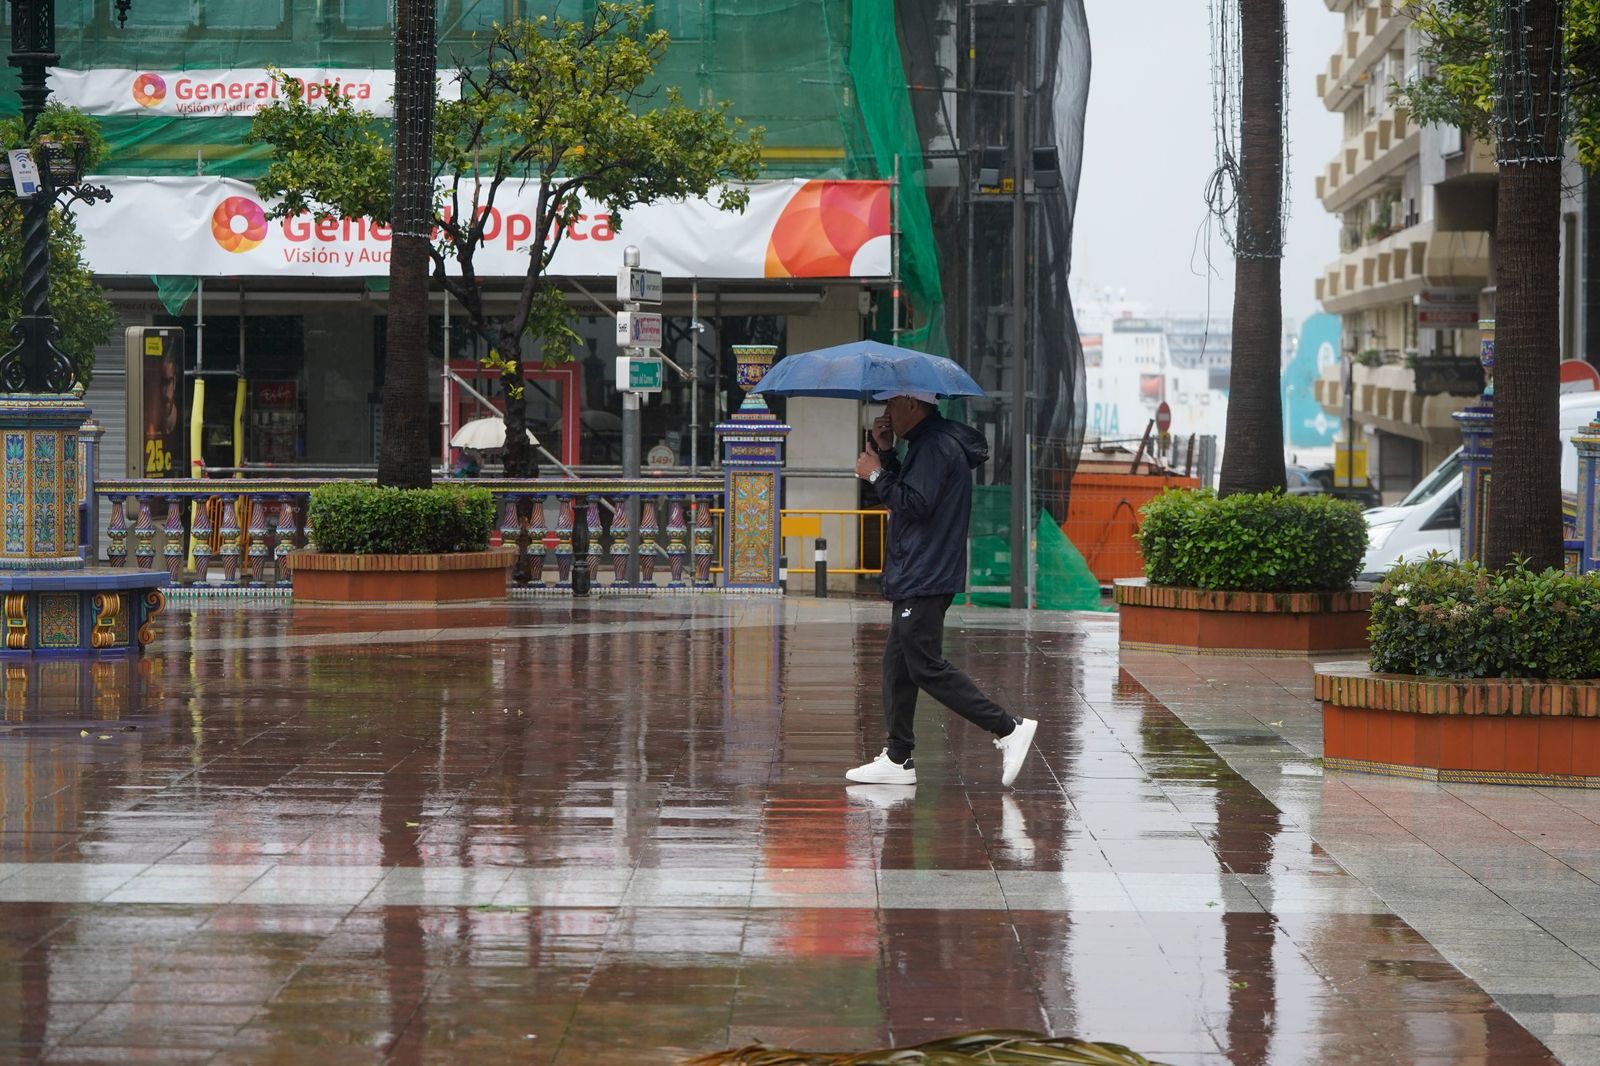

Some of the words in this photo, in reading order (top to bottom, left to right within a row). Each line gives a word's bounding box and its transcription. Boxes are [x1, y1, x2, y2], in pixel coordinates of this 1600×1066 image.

[175, 77, 279, 100] General
[176, 102, 210, 113] Visión
[213, 104, 220, 114] y
[475, 204, 614, 251] Opica
[284, 247, 340, 263] Visión
[345, 251, 354, 267] y
